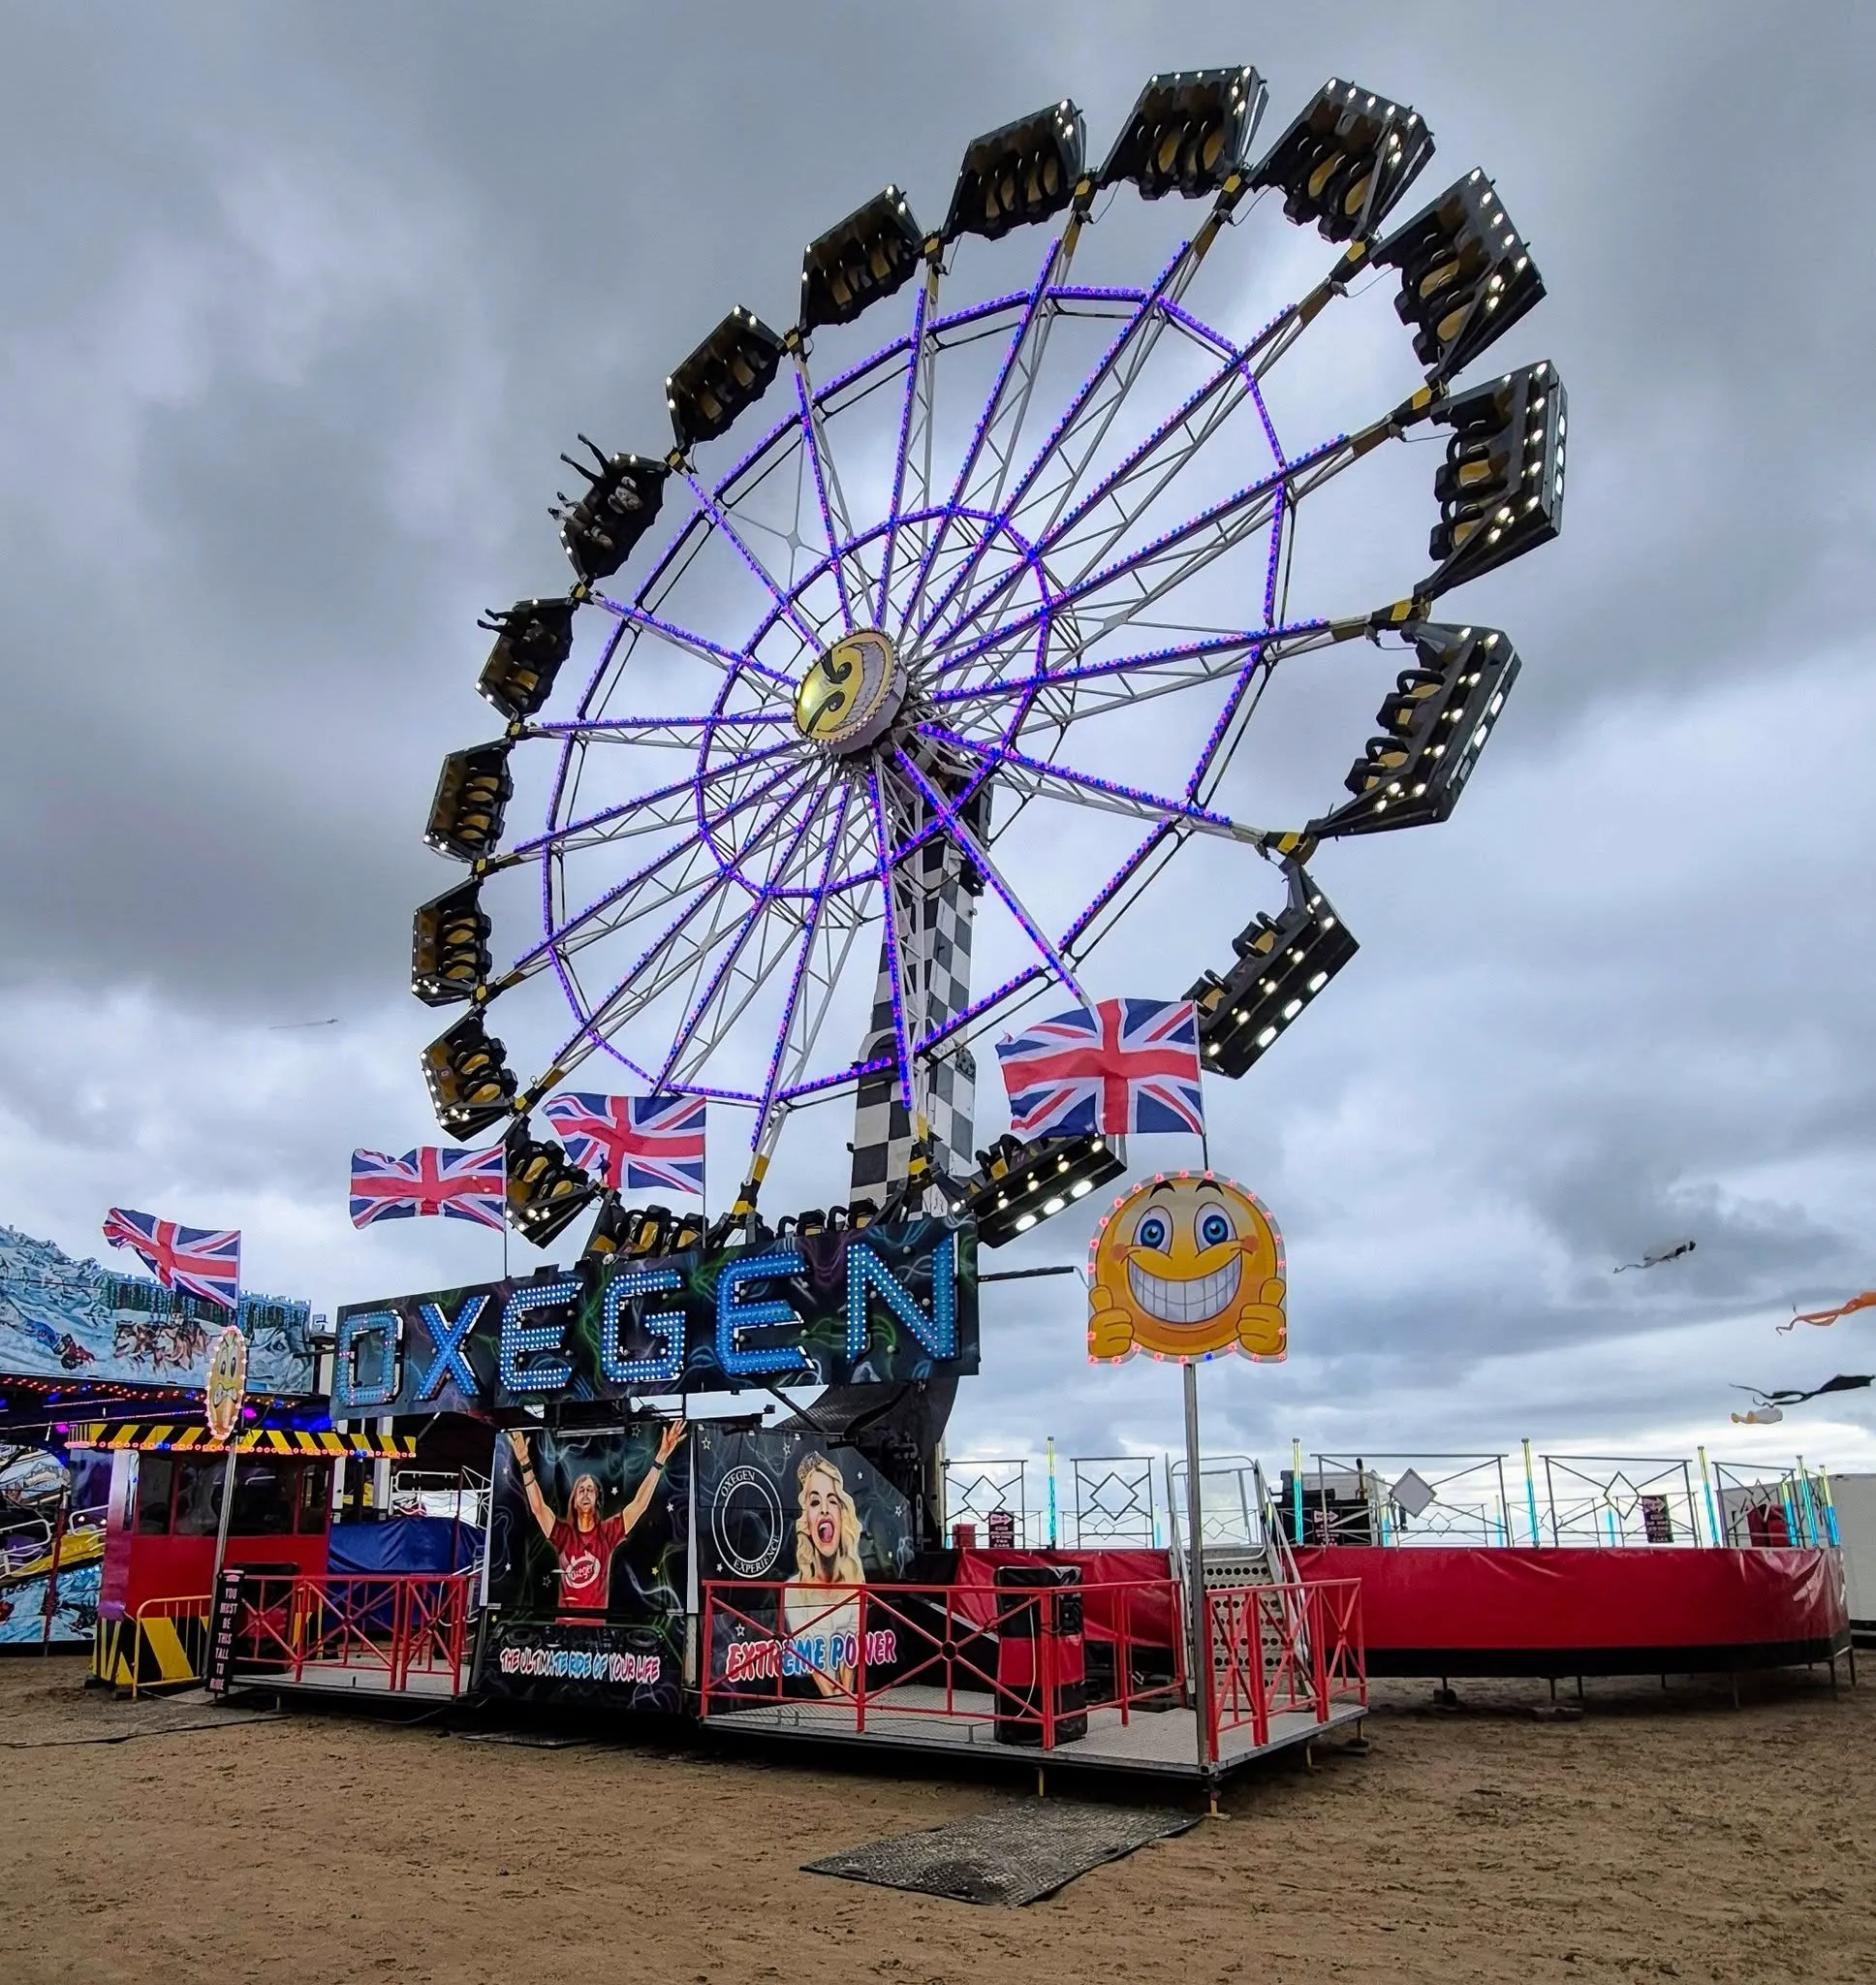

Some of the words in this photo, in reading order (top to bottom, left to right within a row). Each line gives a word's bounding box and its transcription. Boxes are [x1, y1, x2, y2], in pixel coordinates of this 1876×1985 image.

[335, 1231, 958, 1408] OXEGEN
[720, 1469, 756, 1497] OXEGEN
[733, 1534, 780, 1573] EXPERIENCE
[225, 1588, 237, 1599] YOU
[219, 1602, 238, 1614] MUST
[222, 1617, 232, 1629] BE
[217, 1632, 233, 1645] THIS
[215, 1648, 229, 1659] TALL
[726, 1636, 827, 1683] EXTREME
[829, 1629, 897, 1671] POWER
[216, 1662, 224, 1675] TO
[500, 1648, 520, 1674] THE
[520, 1647, 569, 1678] ULTIMATE
[569, 1651, 592, 1680] RIDE
[593, 1652, 609, 1681] OF
[609, 1652, 636, 1684] YOUR
[636, 1654, 661, 1685] LIFE
